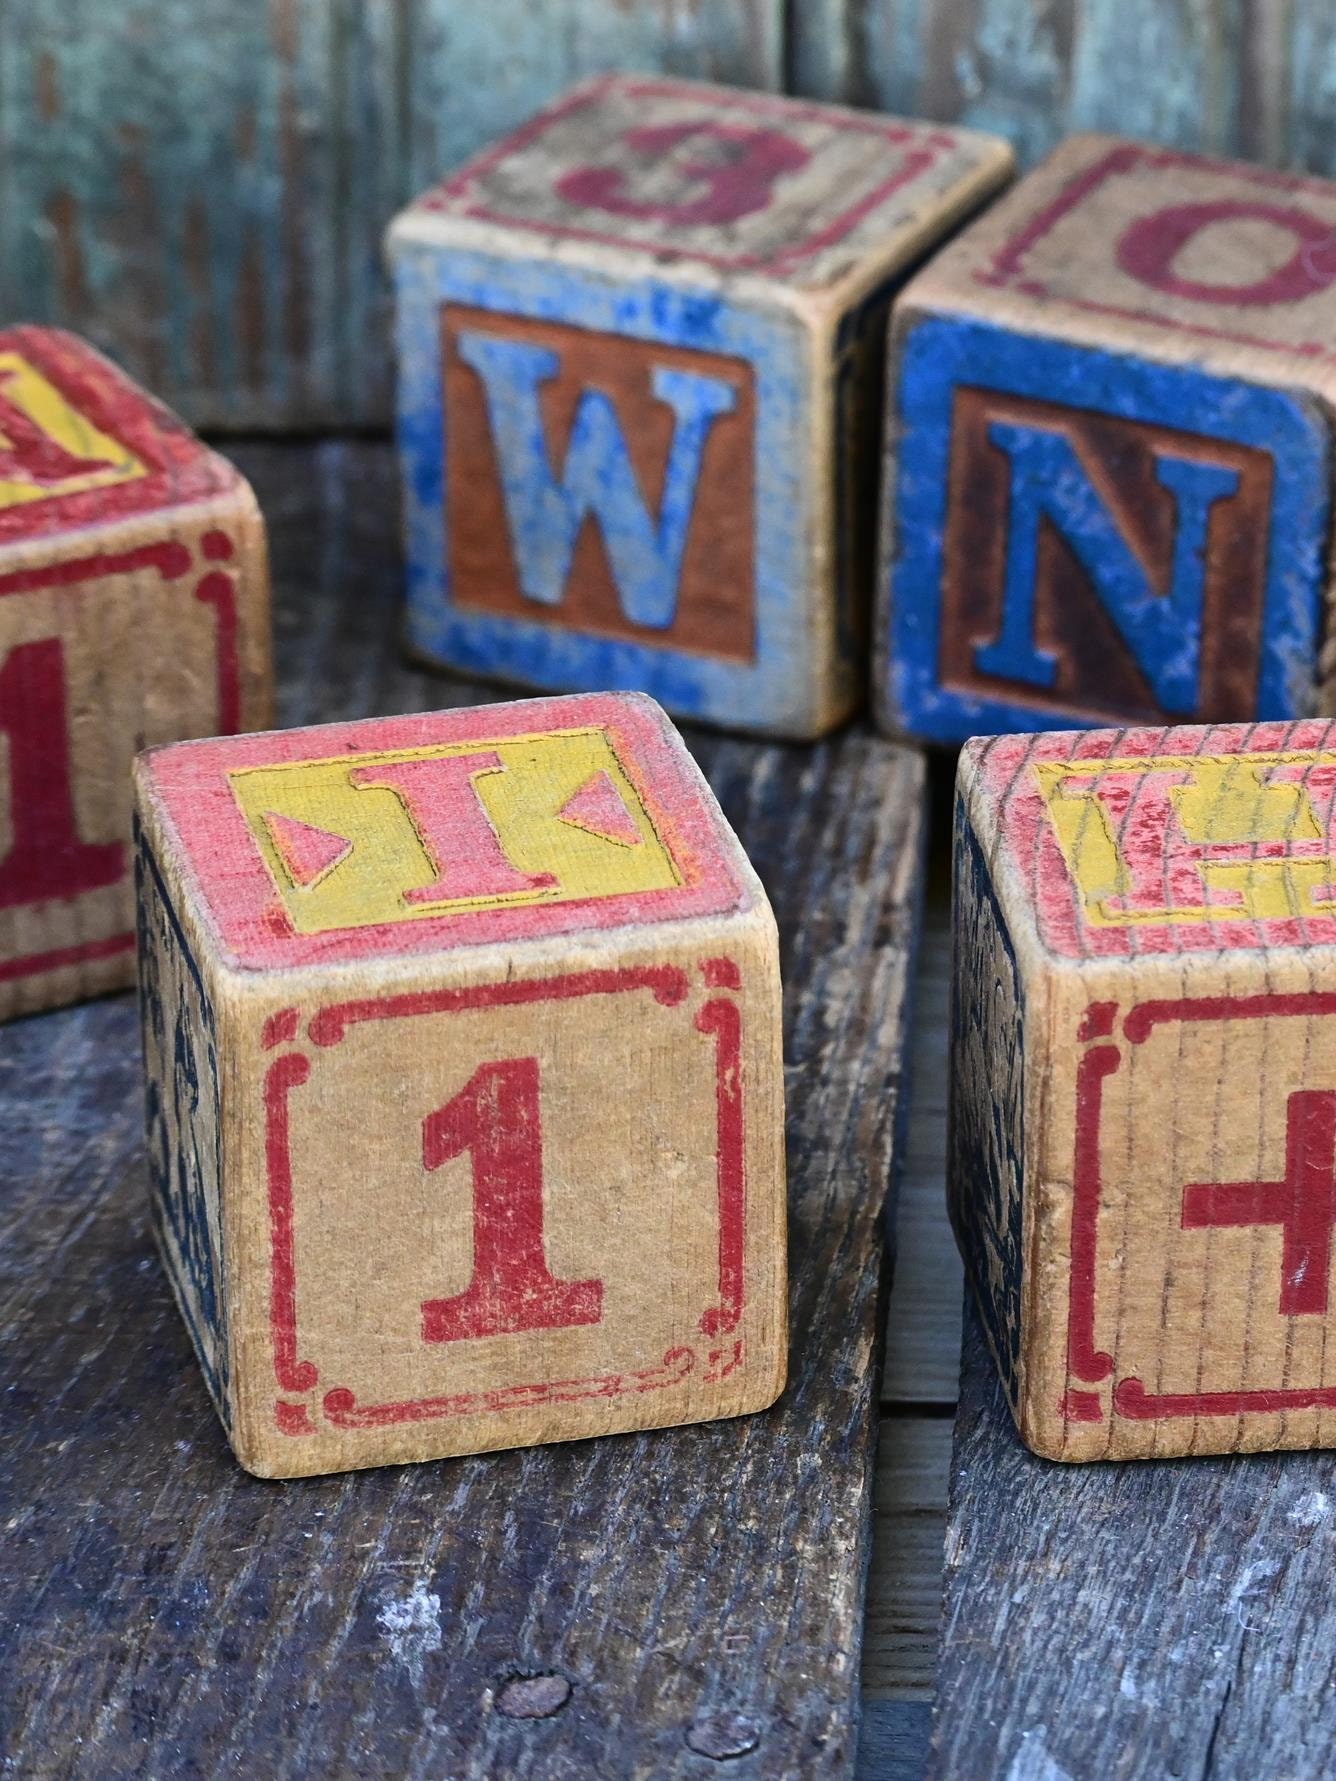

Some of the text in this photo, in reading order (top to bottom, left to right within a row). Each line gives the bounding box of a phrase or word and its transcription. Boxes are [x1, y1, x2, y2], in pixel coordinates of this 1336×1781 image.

[556, 121, 812, 226] 3
[457, 330, 737, 631] W
[970, 419, 1240, 714] N
[0, 636, 126, 900] 1
[350, 751, 562, 904] I
[422, 1057, 603, 1343] 1
